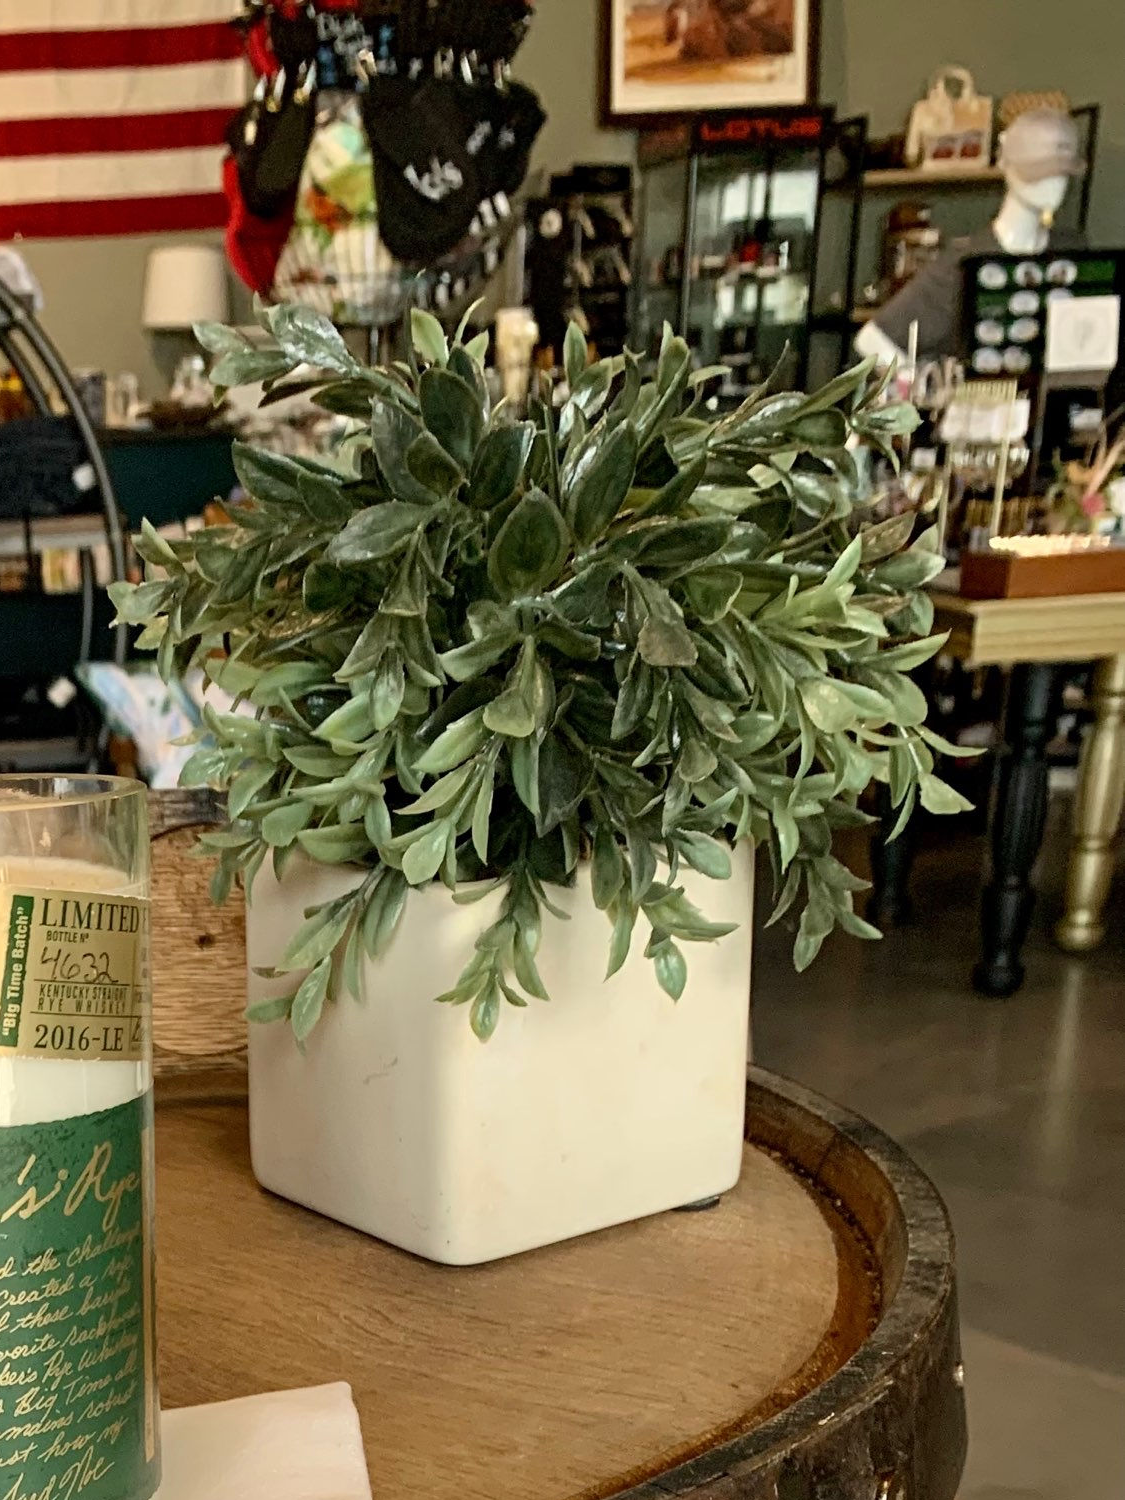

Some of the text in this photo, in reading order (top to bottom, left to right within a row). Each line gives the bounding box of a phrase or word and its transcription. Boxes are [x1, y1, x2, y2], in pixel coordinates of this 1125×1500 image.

[39, 897, 140, 934] LIMITED
[46, 930, 78, 943] BOTTLE
[40, 946, 120, 985] 4632
[38, 998, 126, 1015] RYE WHISKEY
[39, 983, 128, 1001] KENTUCKY STRAIGHT
[33, 1023, 124, 1053] 2016-LE
[63, 1141, 140, 1232] Rye
[22, 1247, 61, 1276] the
[79, 1275, 98, 1289] a
[10, 1302, 74, 1333] these
[42, 1349, 74, 1391] Rye
[14, 1386, 59, 1423] Big
[62, 1375, 113, 1406] Time
[37, 1431, 96, 1462] how
[97, 1416, 129, 1445] my
